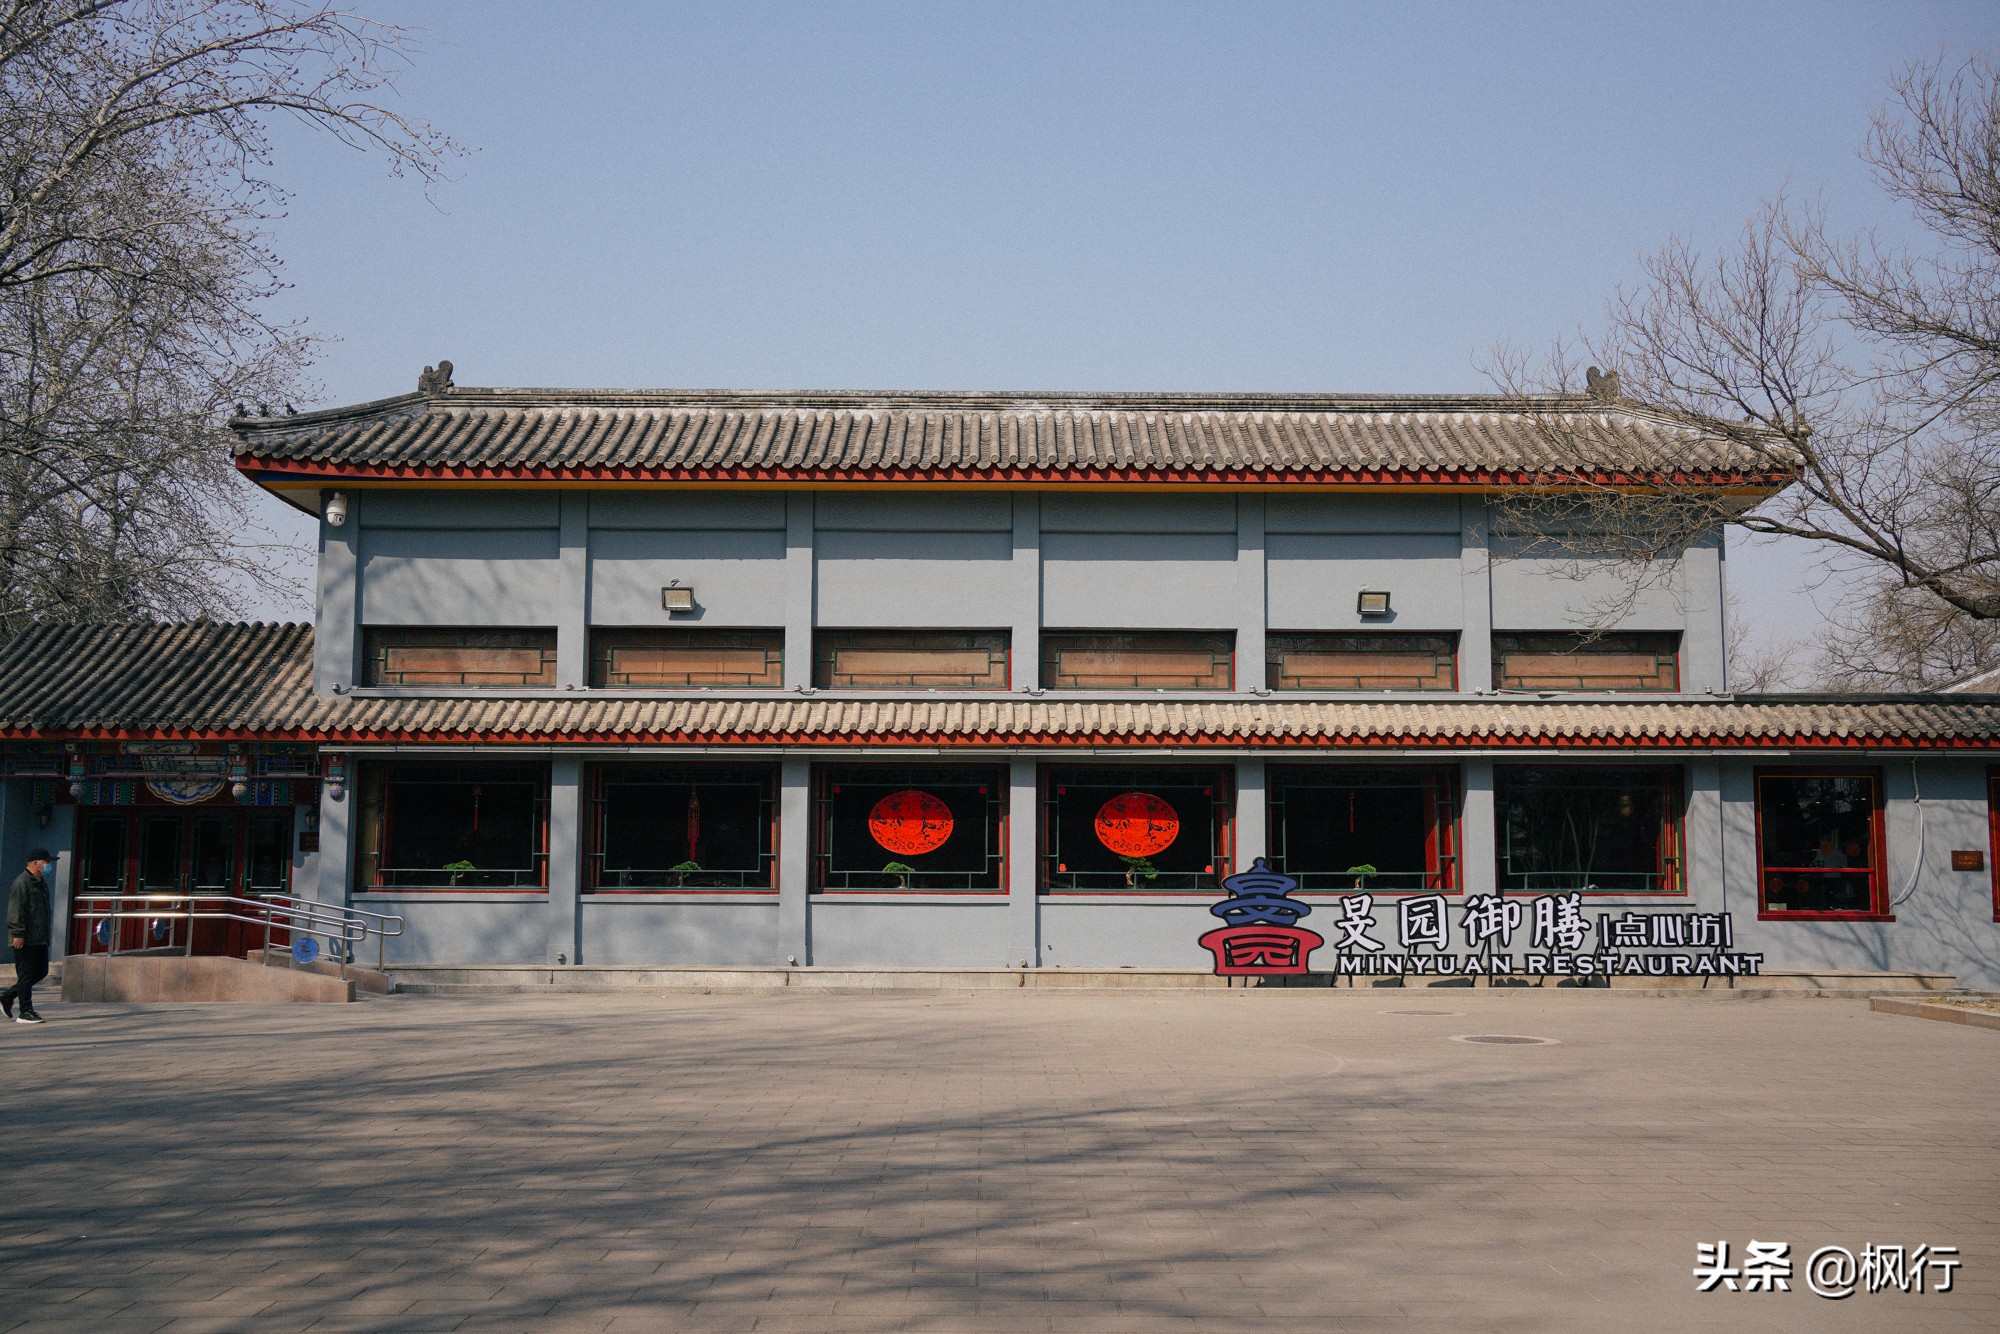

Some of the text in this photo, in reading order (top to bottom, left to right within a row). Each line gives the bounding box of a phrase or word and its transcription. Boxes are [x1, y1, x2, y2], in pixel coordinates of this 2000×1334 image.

[1335, 892, 1590, 951] 旻园御膳
[1338, 954, 1763, 976] MINYUAN RESTAURANT
